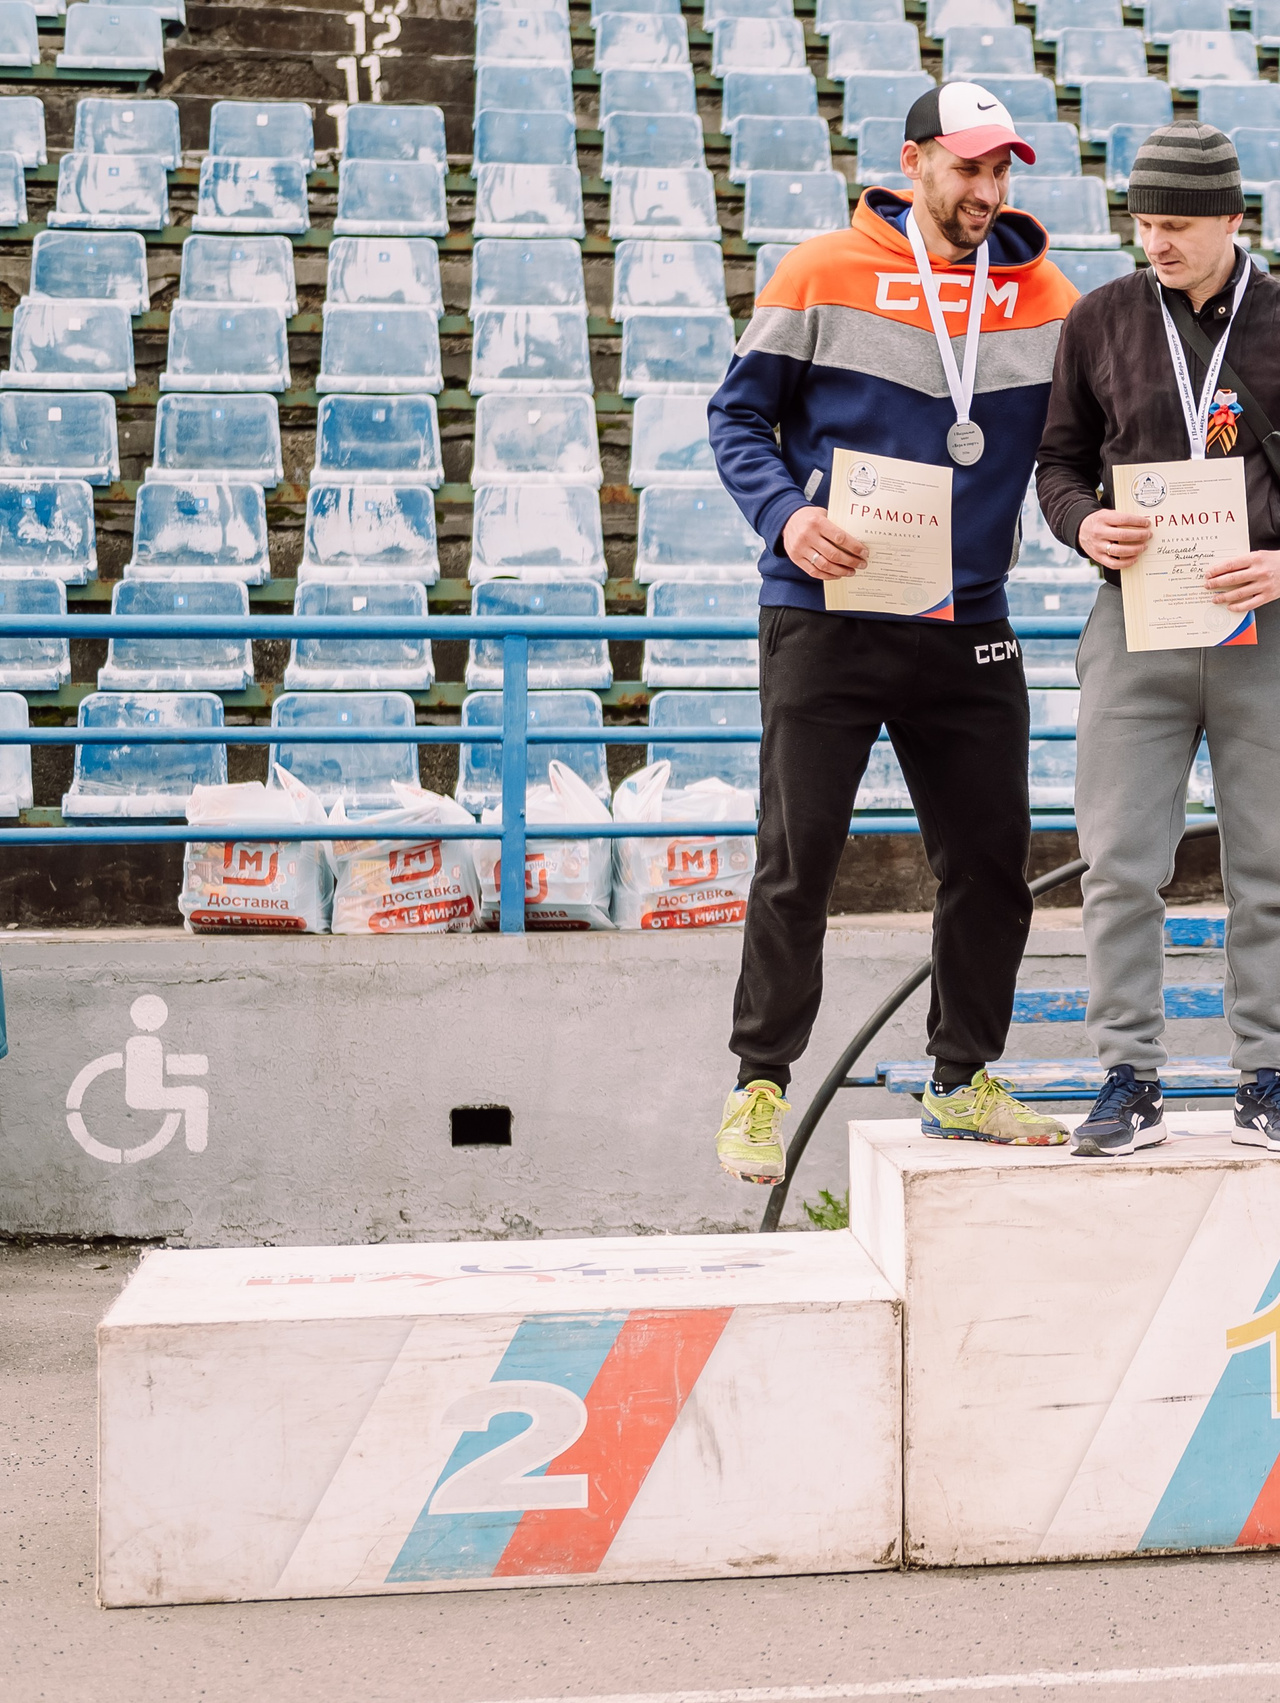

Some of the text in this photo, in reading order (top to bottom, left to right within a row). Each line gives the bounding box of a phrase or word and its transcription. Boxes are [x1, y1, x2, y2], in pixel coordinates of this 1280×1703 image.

[345, 11, 403, 58] 12
[336, 54, 383, 103] 11
[875, 271, 1020, 319] CCM
[850, 503, 940, 527] ГРАМОТА
[864, 529, 922, 539] НАГРАЖДАЕТСЯ
[1161, 535, 1219, 543] НАГРАЖДАЕТСЯ
[974, 639, 1019, 665] CCM
[207, 893, 289, 910] Доставка
[382, 884, 462, 908] Доставка
[656, 888, 734, 909] Доставка
[201, 915, 220, 924] от
[246, 916, 297, 928] минут
[379, 902, 469, 929] от 15 минут
[491, 910, 568, 921] Дтавка
[651, 906, 742, 929] от 15 минут
[428, 1379, 590, 1516] 2
